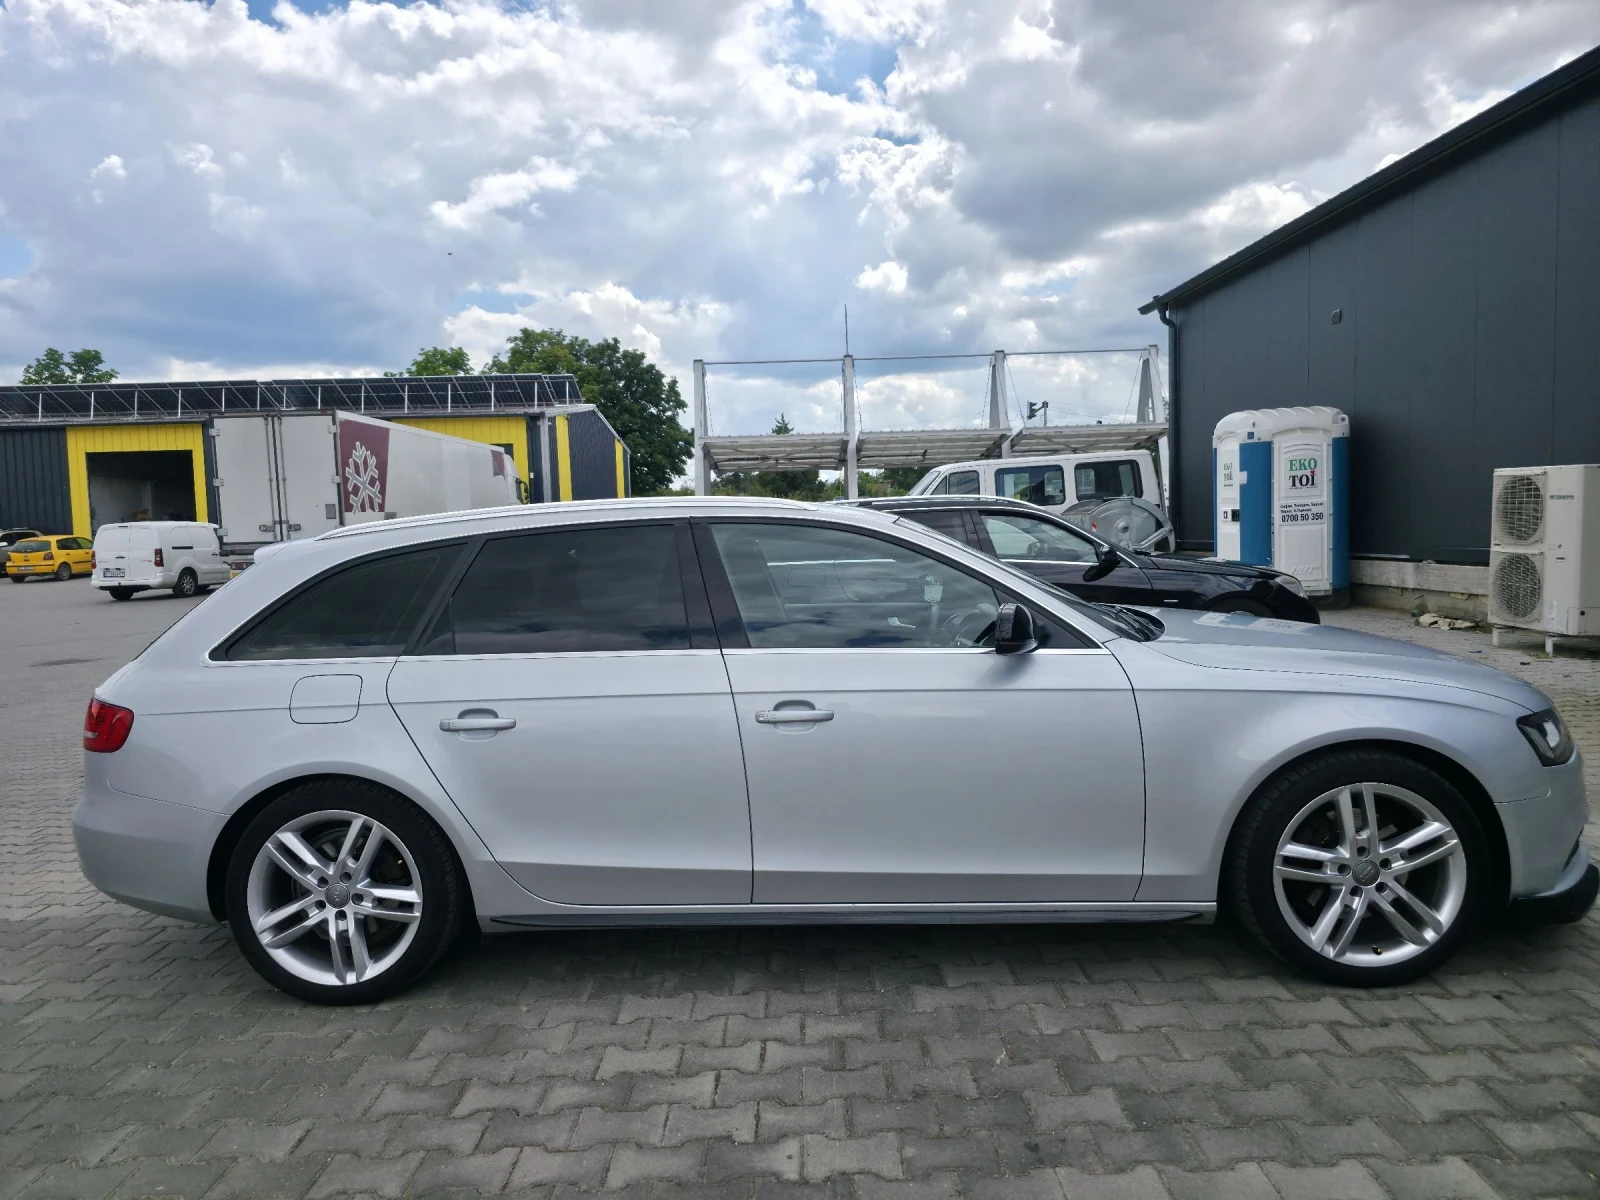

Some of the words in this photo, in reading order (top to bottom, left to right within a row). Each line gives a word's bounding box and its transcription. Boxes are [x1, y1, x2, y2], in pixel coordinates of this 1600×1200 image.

[1289, 458, 1318, 471] EKO
[1281, 514, 1299, 522] 0700
[1300, 513, 1309, 521] 50
[1311, 512, 1324, 520] 350
